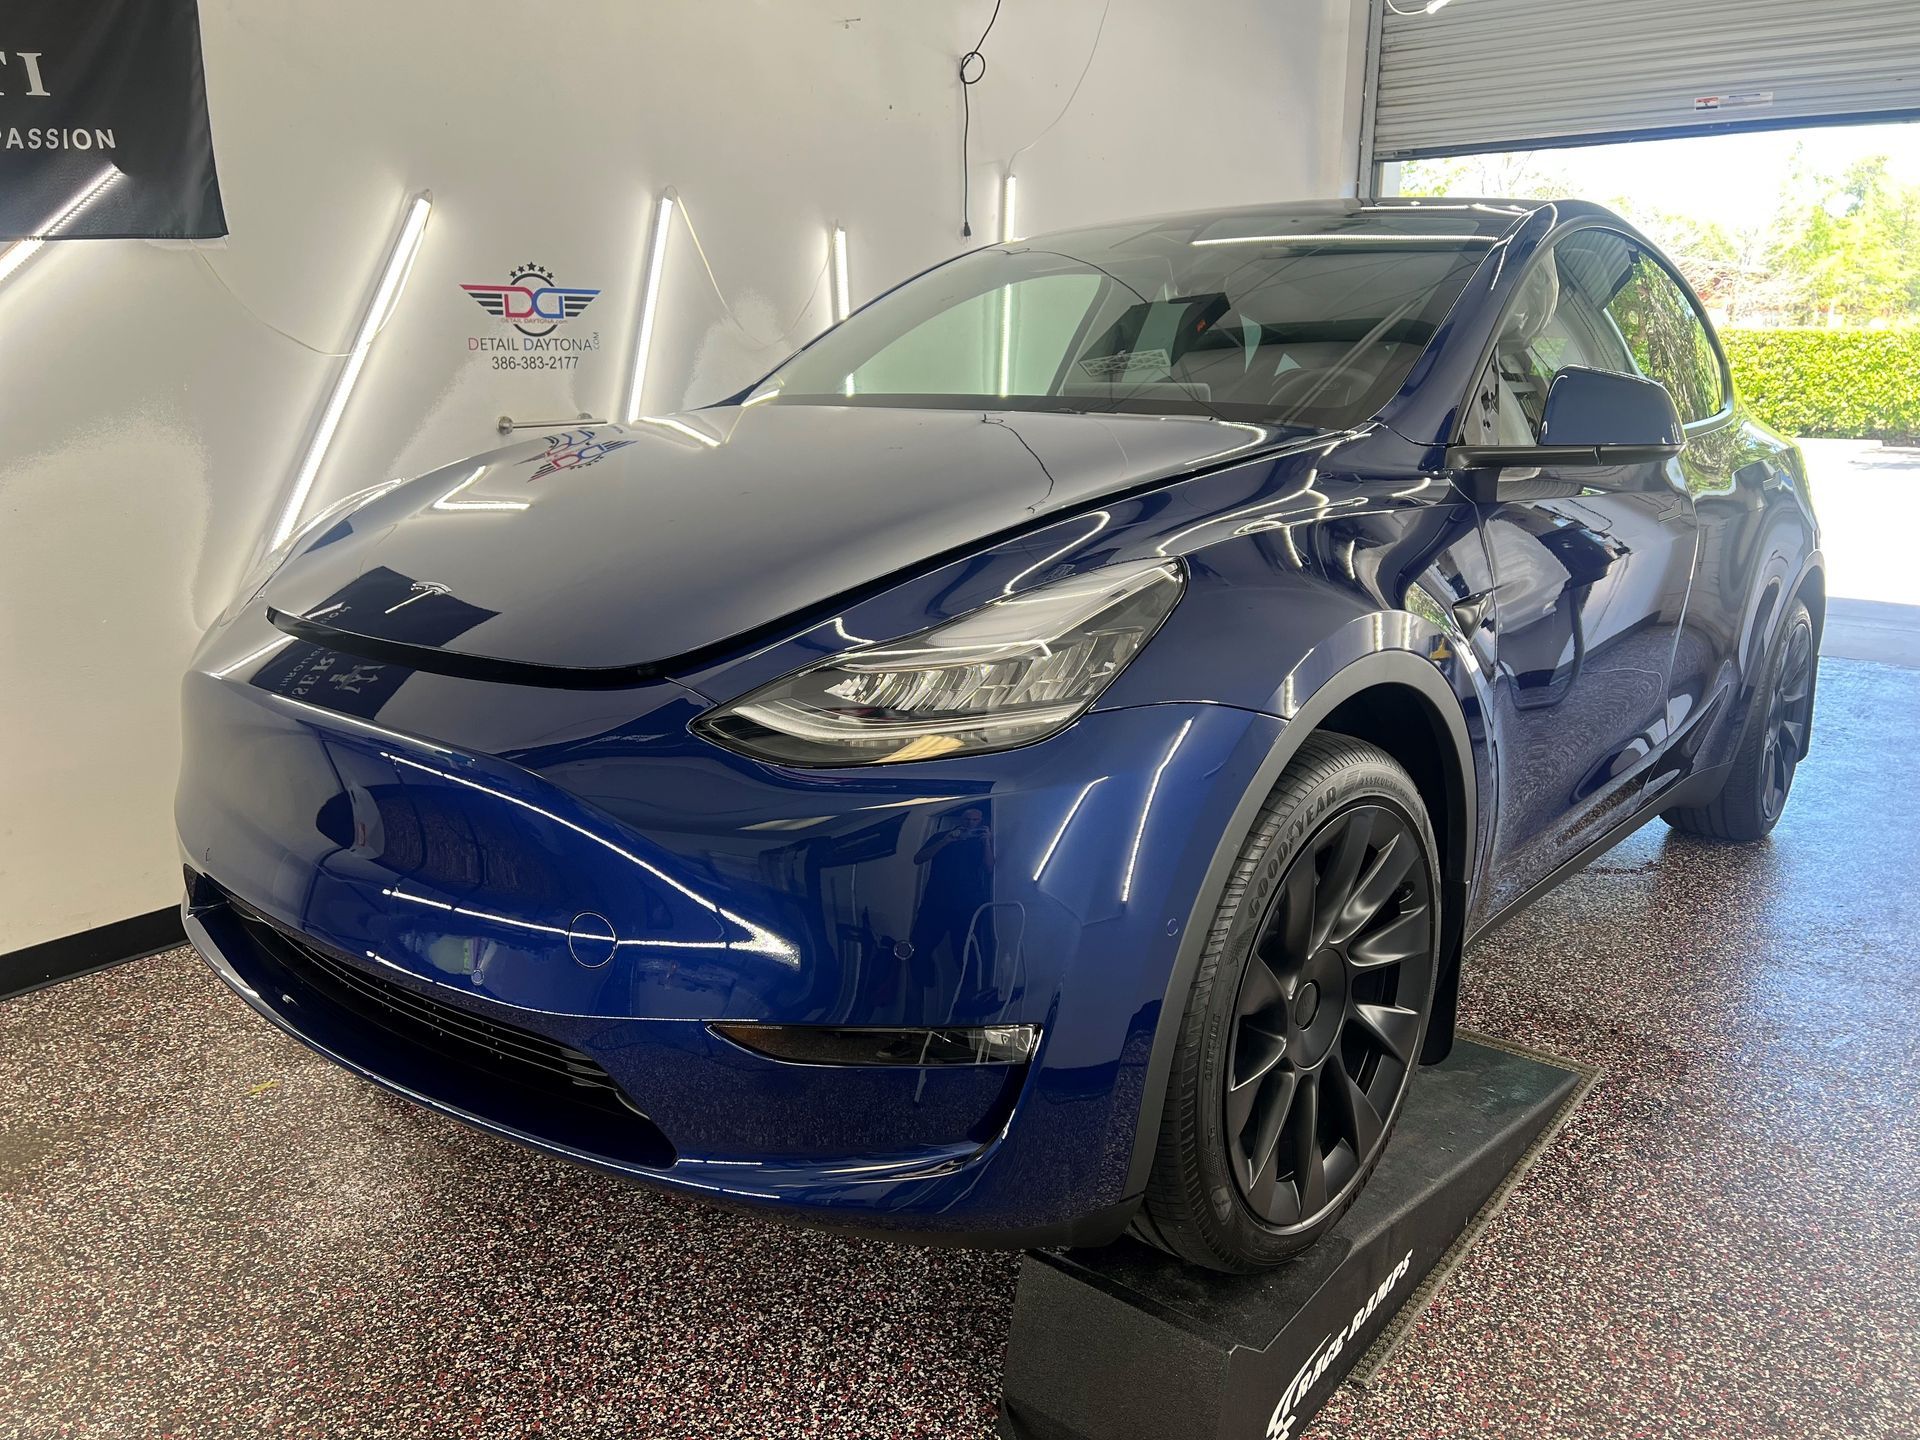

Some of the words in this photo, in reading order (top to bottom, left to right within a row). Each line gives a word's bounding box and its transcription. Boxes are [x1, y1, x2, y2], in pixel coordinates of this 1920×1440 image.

[0, 127, 116, 150] ASSION
[468, 337, 519, 351] DETAIL
[523, 338, 592, 351] DAYTONA
[492, 356, 579, 370] 386-383-2177
[1249, 786, 1337, 918] GOODYEAR
[1293, 1325, 1349, 1408] RACE
[1347, 1248, 1413, 1341] RAMPS
